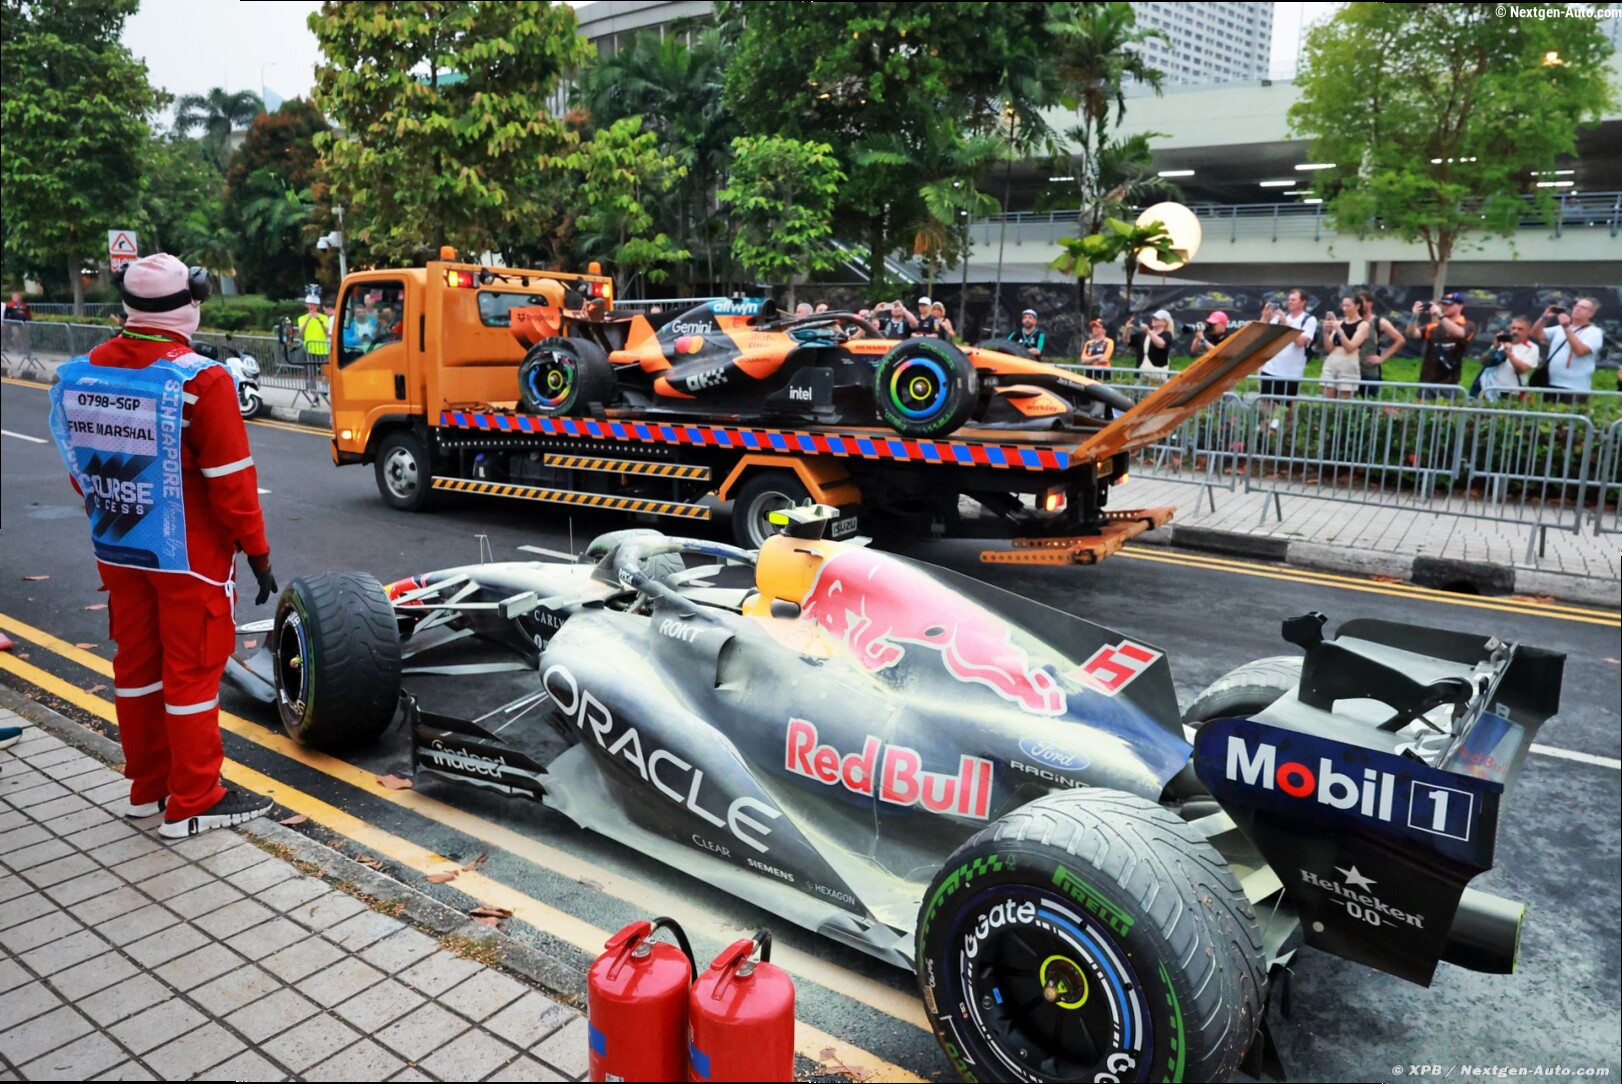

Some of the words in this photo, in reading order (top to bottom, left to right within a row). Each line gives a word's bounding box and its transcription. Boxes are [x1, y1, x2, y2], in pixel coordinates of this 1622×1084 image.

[713, 299, 758, 315] allwyn
[672, 320, 712, 335] Gemini
[77, 393, 141, 411] 0798-SGP
[789, 386, 813, 401] intel
[68, 420, 94, 434] FIRE
[96, 424, 155, 441] MARSHAL
[160, 379, 181, 499] SINGAPORE
[833, 518, 857, 535] ISUZU
[619, 568, 634, 585] VISA
[534, 609, 565, 629] CARLY
[659, 619, 703, 643] ROKT
[542, 664, 783, 853] ORACLE
[1031, 740, 1076, 767] Ford
[785, 718, 881, 797] Red
[878, 743, 994, 820] Bull
[1225, 735, 1395, 822] Mobil
[1428, 789, 1449, 832] 1
[692, 834, 731, 858] CLEAR
[747, 858, 795, 883] SIEMENS
[815, 883, 855, 906] HEXAGON
[1051, 864, 1135, 938] PIRELLI
[1300, 869, 1424, 930] Heineken
